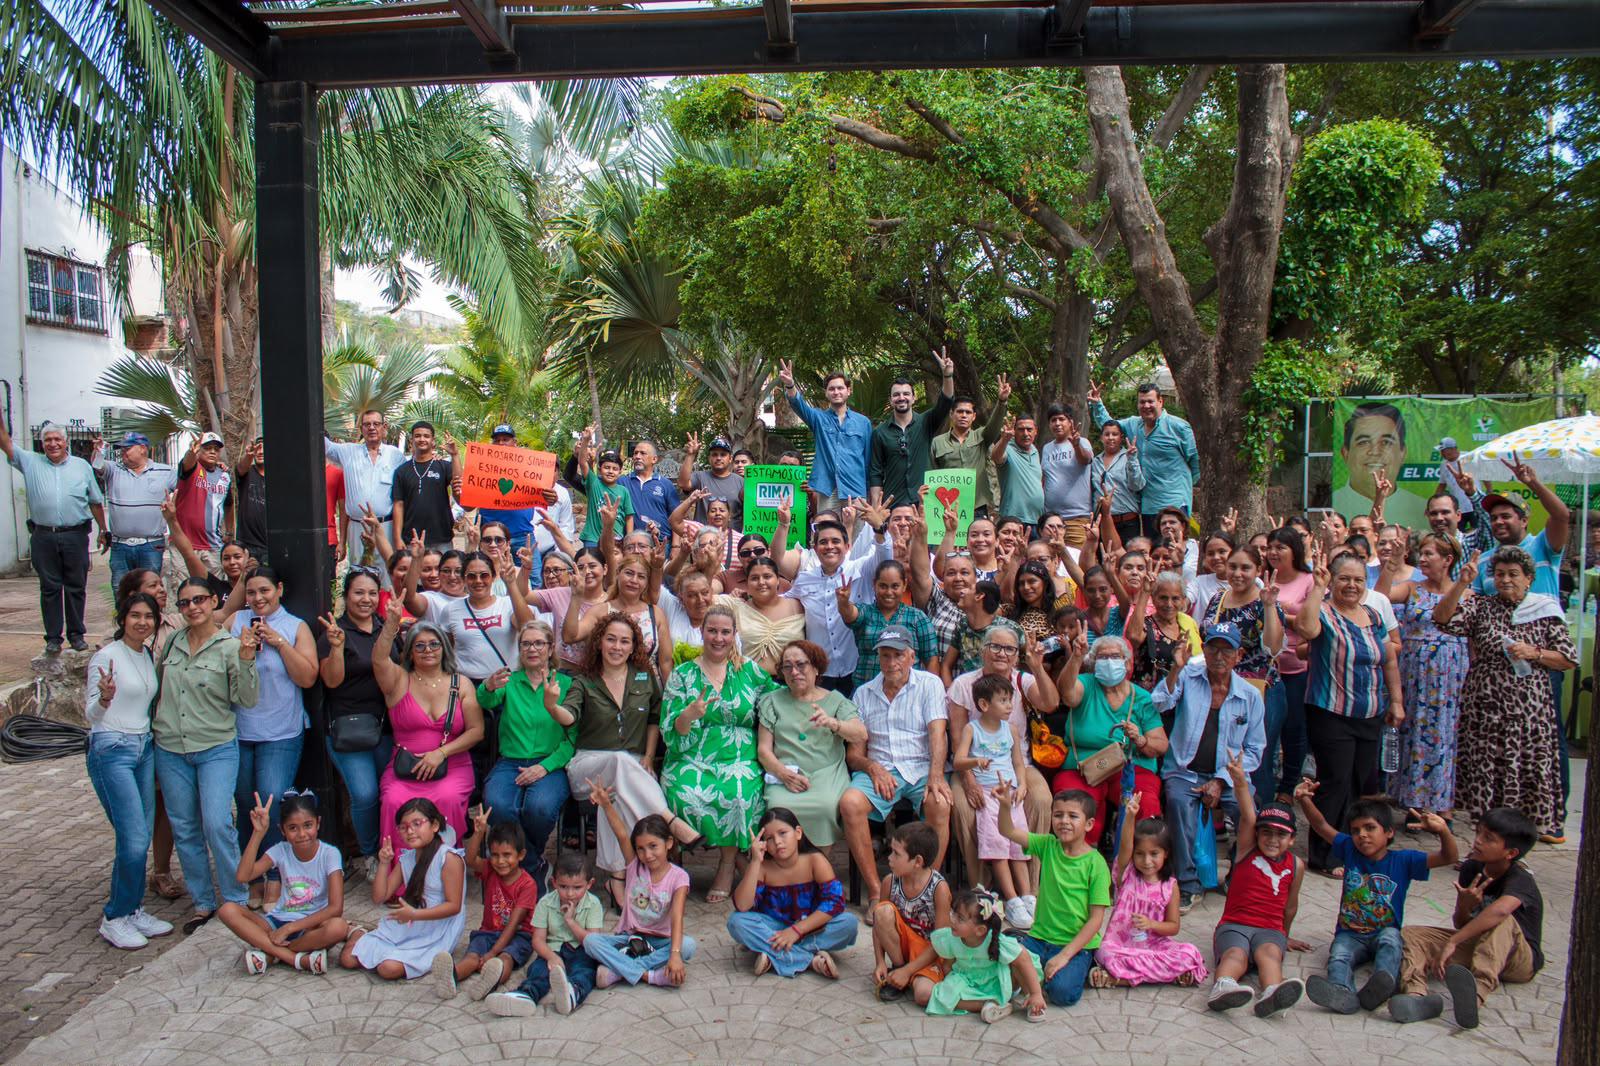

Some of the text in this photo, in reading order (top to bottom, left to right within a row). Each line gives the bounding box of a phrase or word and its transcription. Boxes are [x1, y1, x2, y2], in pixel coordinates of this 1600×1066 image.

[487, 448, 524, 463] ROSARIO
[478, 462, 543, 481] ESTAMOS CON
[746, 467, 793, 480] ESTAMOS
[1403, 467, 1421, 478] EL
[467, 474, 498, 490] RICAR
[928, 475, 973, 485] ROSARIO
[759, 485, 790, 498] RIMA
